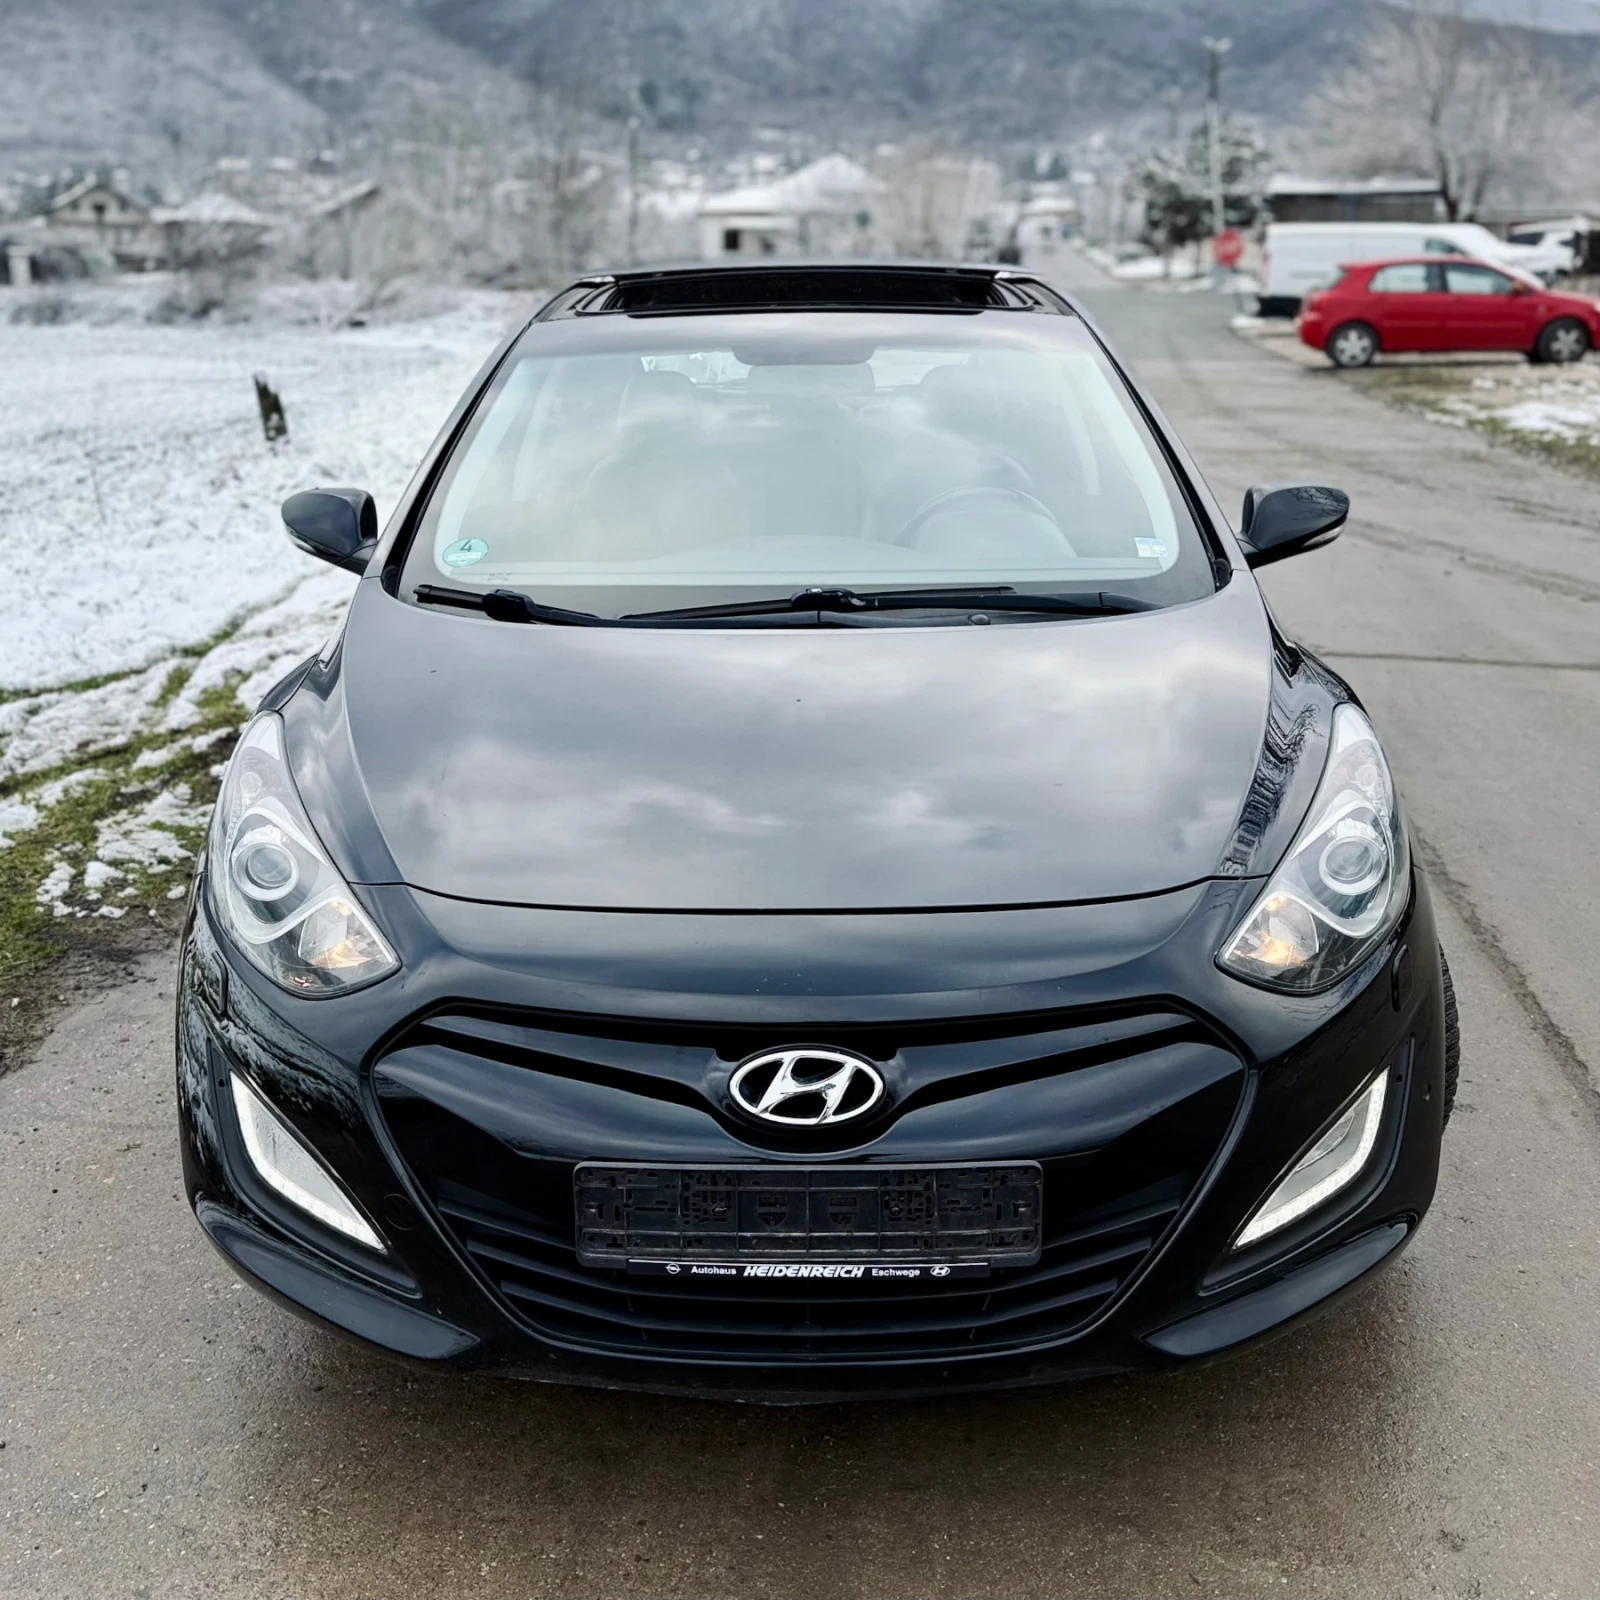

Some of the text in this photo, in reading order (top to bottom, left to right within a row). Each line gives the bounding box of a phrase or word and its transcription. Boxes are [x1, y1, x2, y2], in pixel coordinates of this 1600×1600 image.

[460, 539, 472, 552] 4
[690, 1265, 737, 1275] Autohaus
[743, 1265, 865, 1277] HEIDENREICH
[871, 1268, 920, 1278] Eschwege
